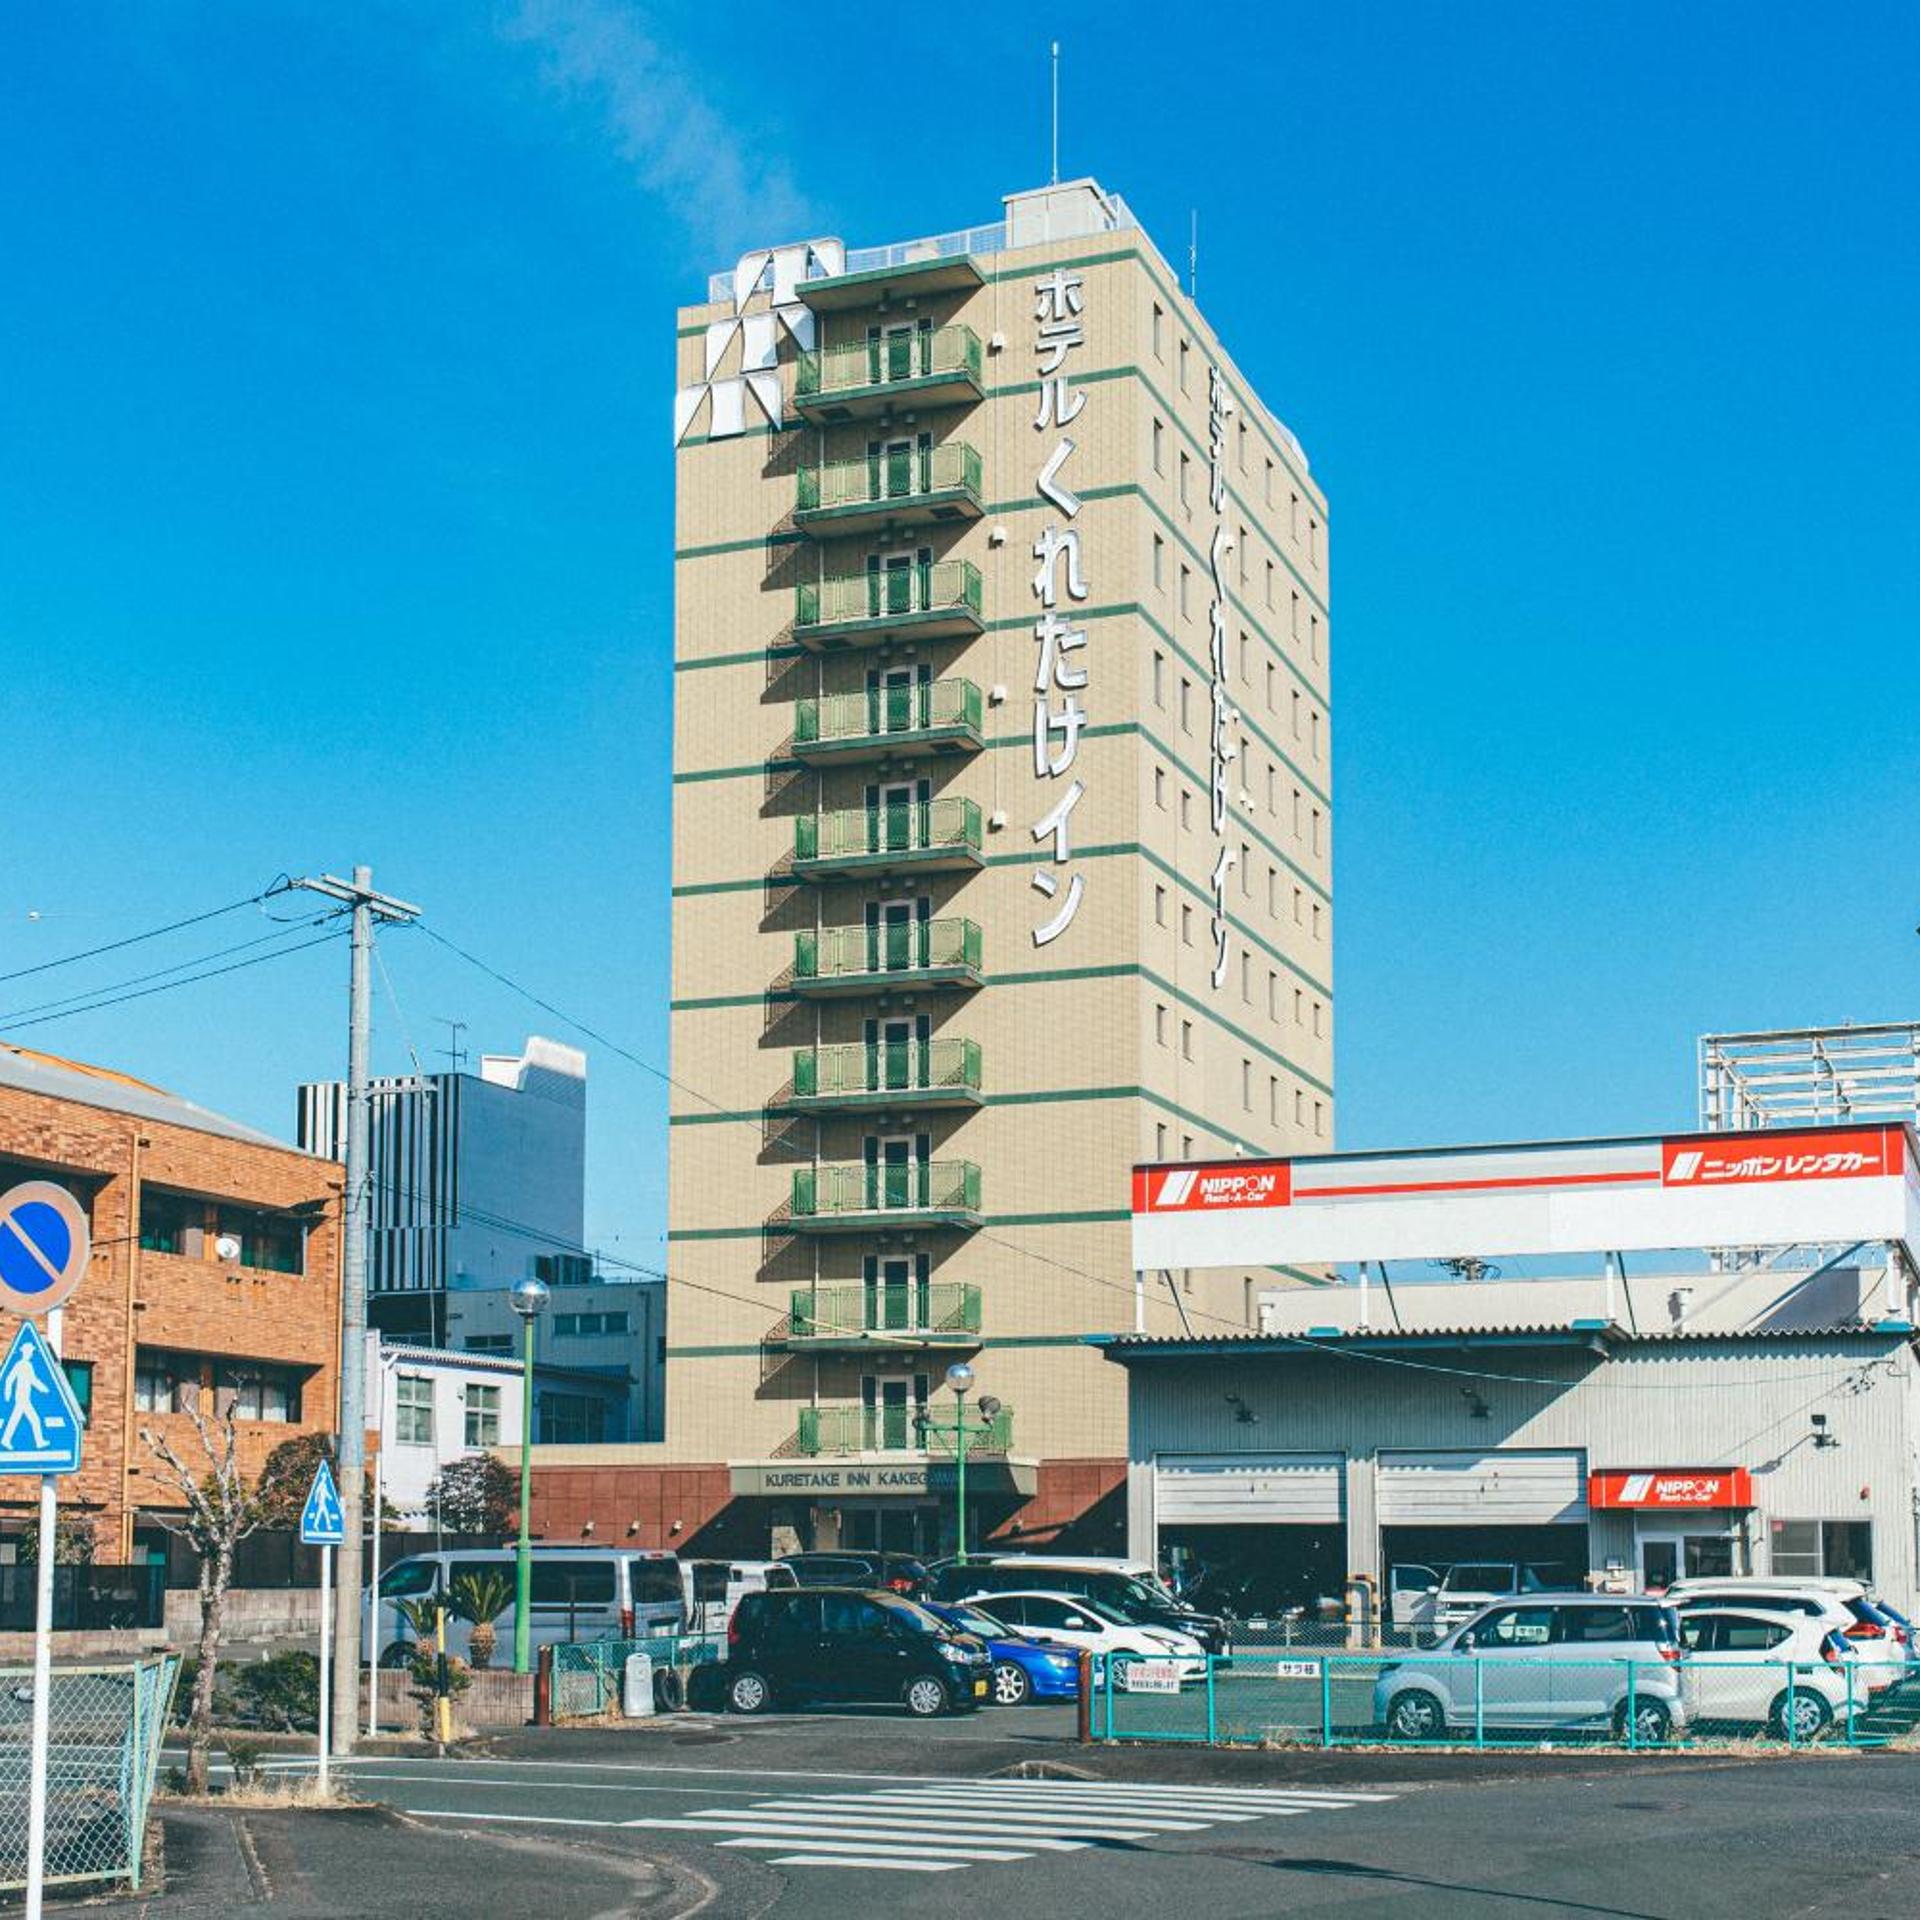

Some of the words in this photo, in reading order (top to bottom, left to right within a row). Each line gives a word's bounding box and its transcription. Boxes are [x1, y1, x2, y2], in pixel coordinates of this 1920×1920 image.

[1200, 1175, 1275, 1194] NIPPON
[1204, 1192, 1267, 1204] Rent-A-Car
[766, 1473, 840, 1487] KURETAKE
[847, 1472, 871, 1486] INN
[1656, 1479, 1720, 1494] NIPPON
